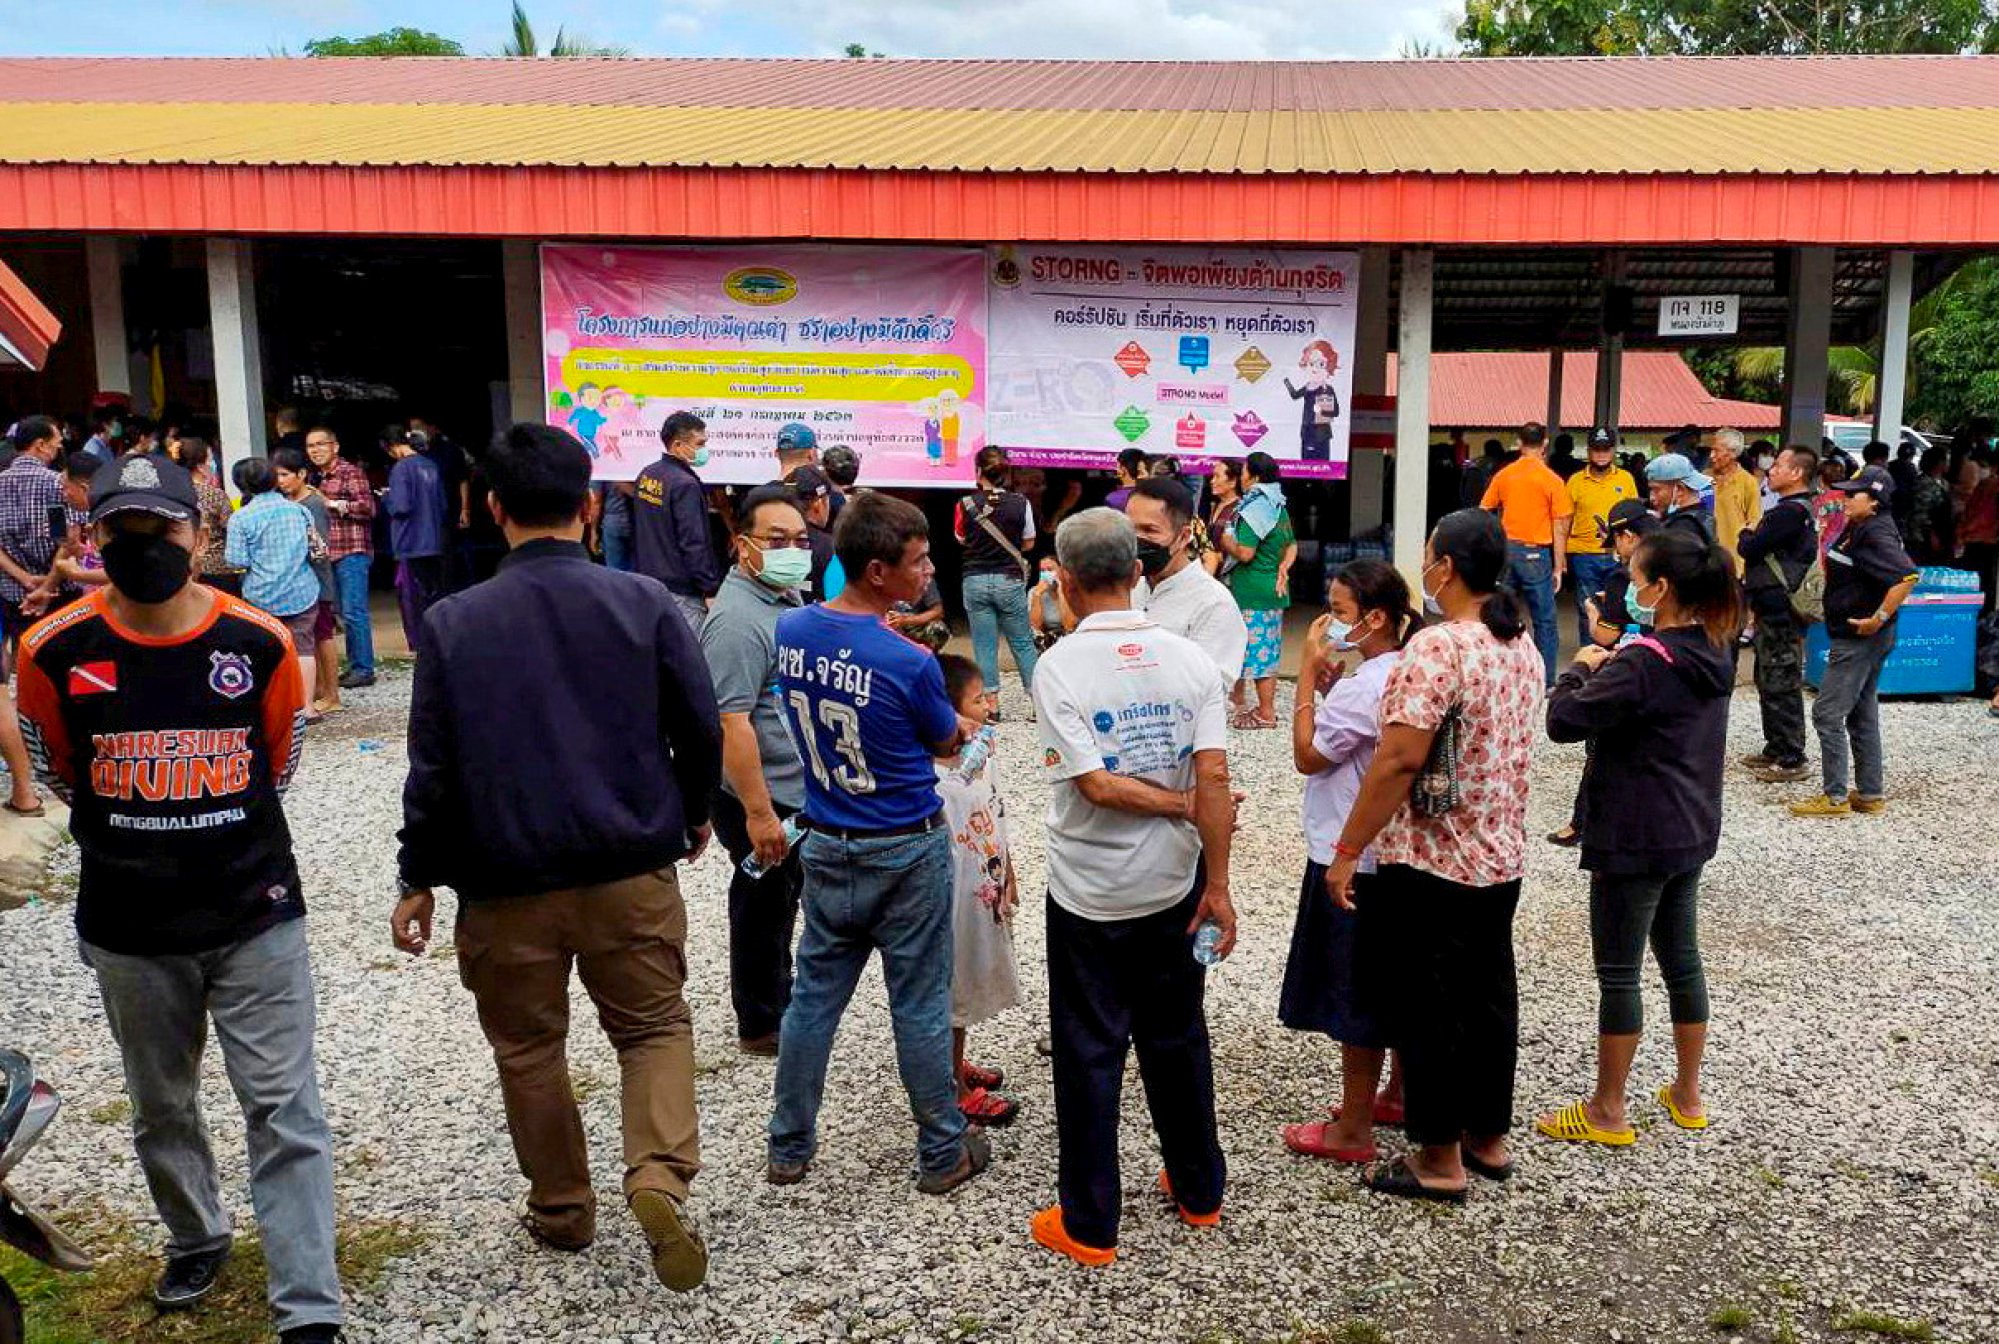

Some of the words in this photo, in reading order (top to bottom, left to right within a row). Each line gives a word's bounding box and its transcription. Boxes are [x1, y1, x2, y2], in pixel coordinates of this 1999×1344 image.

[1031, 256, 1120, 282] STORNG
[1054, 304, 1126, 327] คอร์รัปชัน
[1136, 302, 1217, 329] เริ่มที่ตัวเรา
[1700, 300, 1725, 315] 118
[789, 689, 876, 795] 13
[90, 749, 253, 801] DIVING
